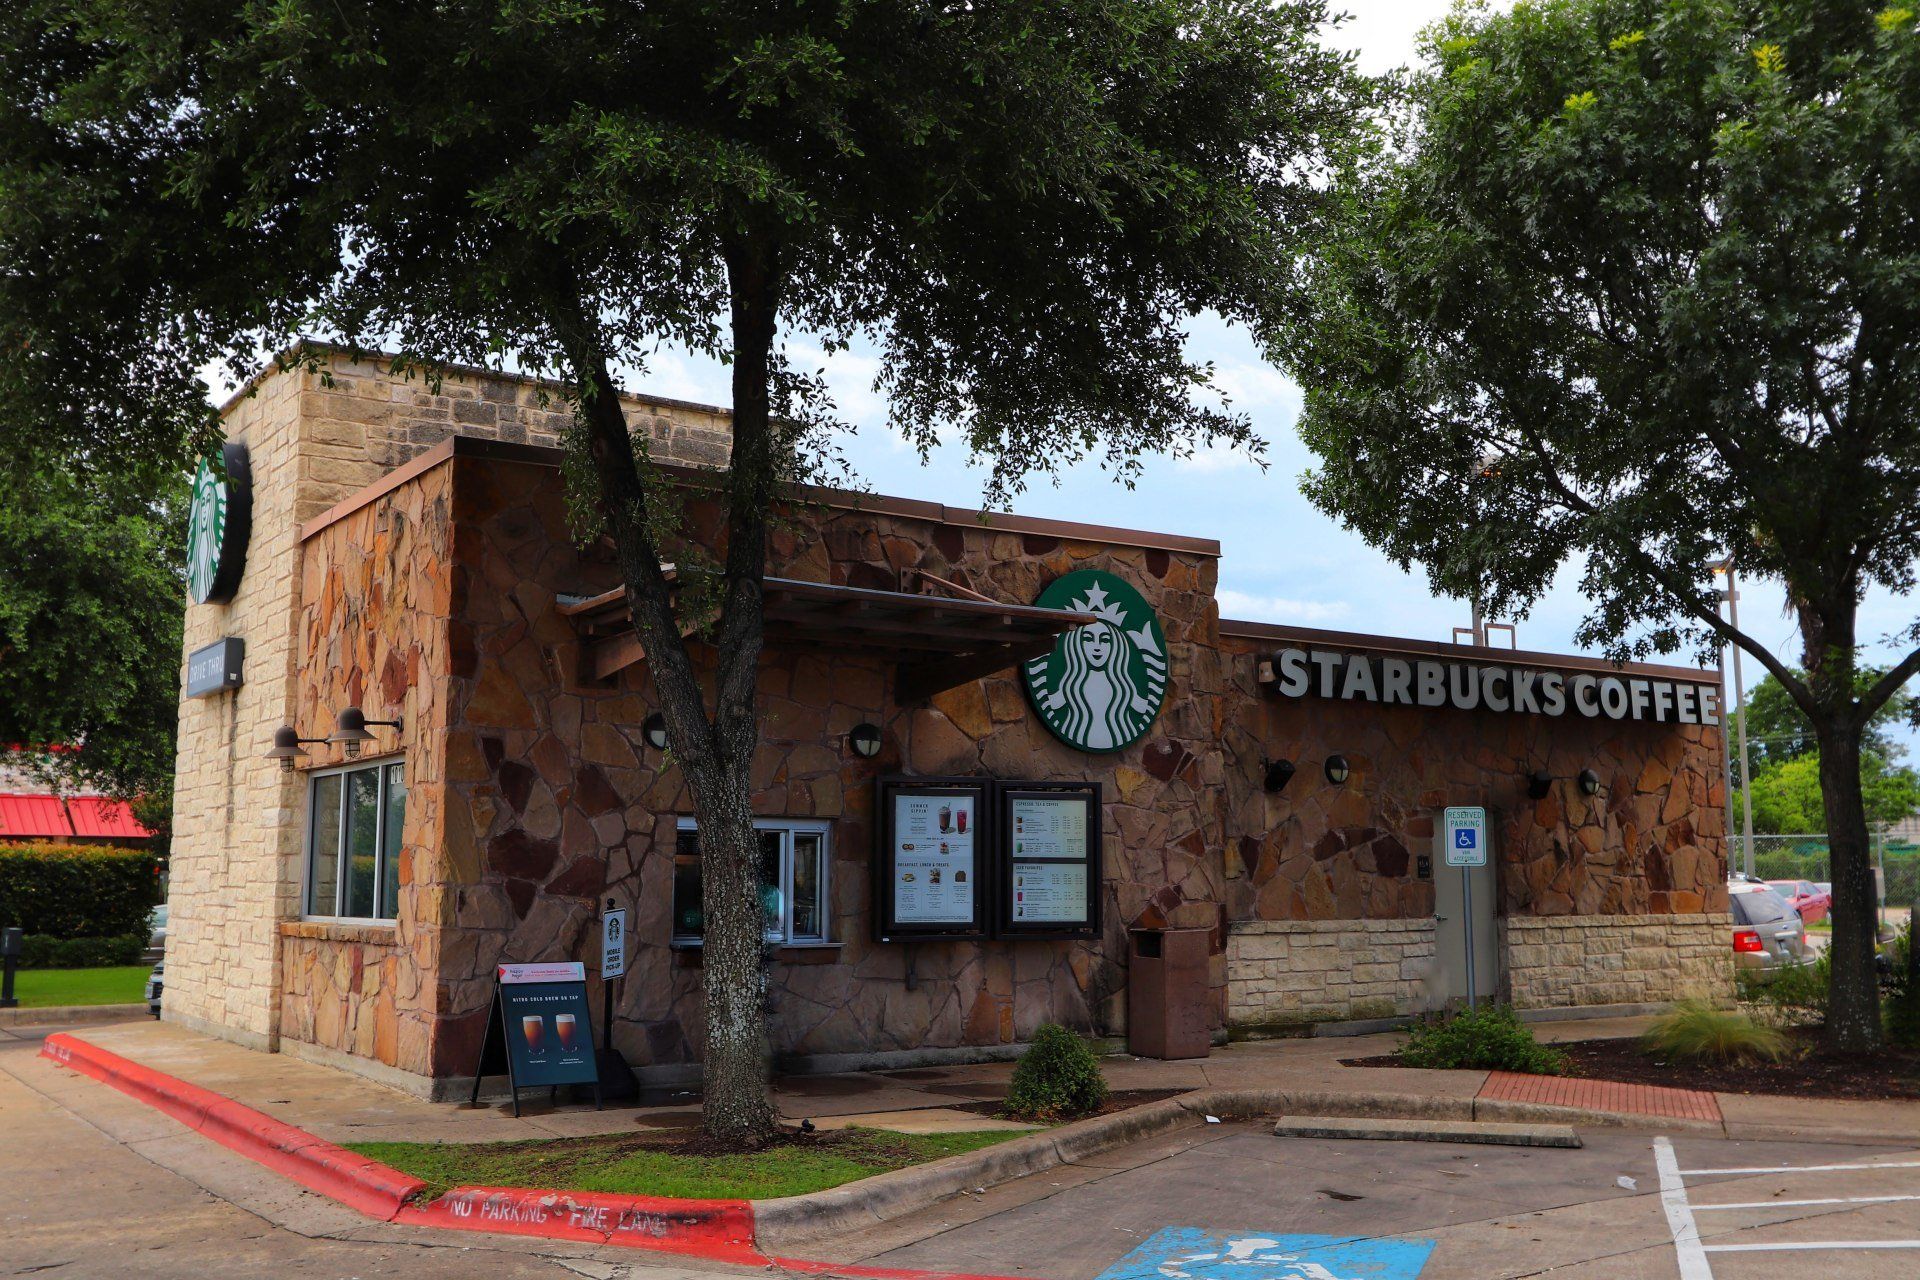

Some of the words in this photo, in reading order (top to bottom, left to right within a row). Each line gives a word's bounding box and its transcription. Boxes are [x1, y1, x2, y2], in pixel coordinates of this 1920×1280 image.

[190, 661, 206, 683] DRIVE
[208, 655, 225, 679] THRU
[1278, 648, 1566, 717] STARBUCKS
[1573, 673, 1719, 726] COFFEE
[1447, 811, 1482, 819] RESERVED
[1450, 820, 1480, 828] PARKING
[606, 947, 621, 956] MOBILE
[607, 955, 620, 963] ORDER
[450, 1200, 472, 1217] NO
[480, 1200, 548, 1222] PARKING
[569, 1204, 610, 1229] FIRE
